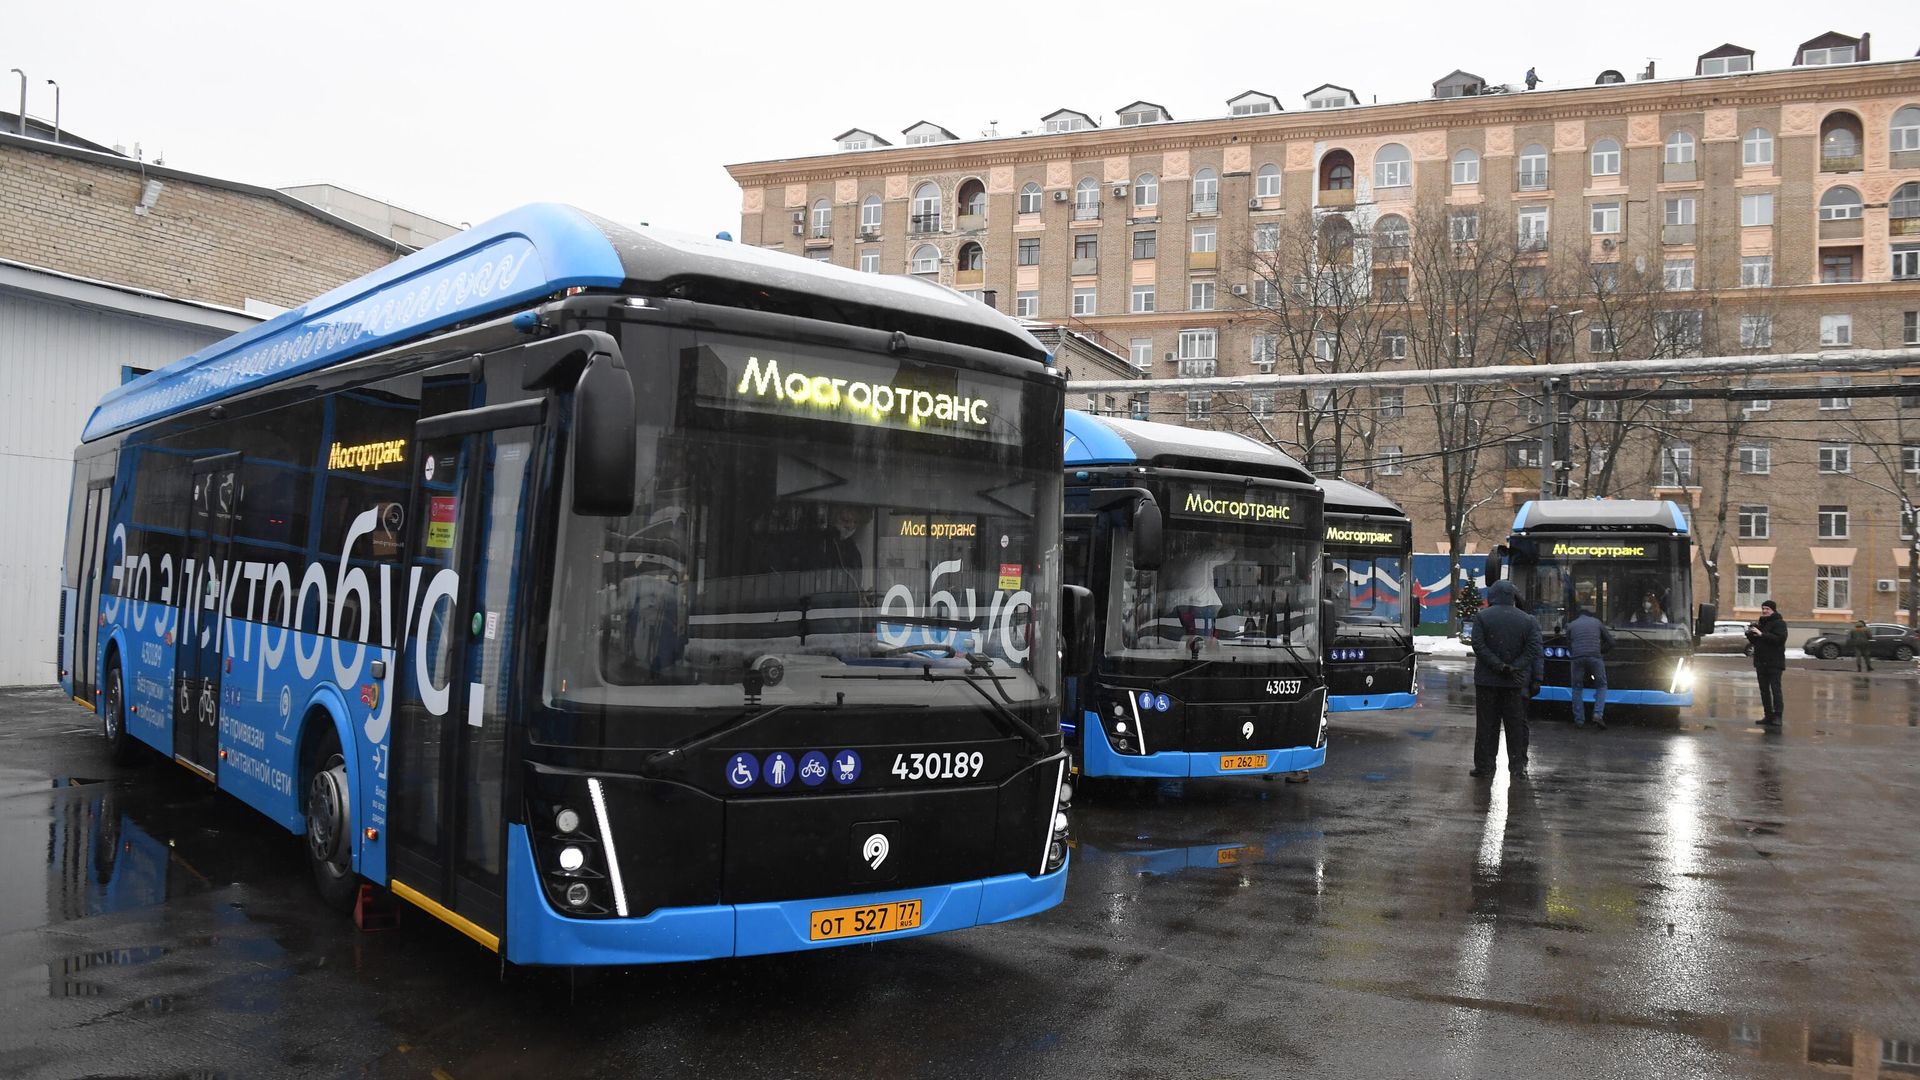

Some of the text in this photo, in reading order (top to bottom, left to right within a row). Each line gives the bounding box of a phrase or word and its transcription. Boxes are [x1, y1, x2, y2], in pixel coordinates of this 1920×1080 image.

[738, 356, 989, 427] Мосгортранс
[328, 439, 405, 471] Мосгортранс
[1184, 493, 1290, 520] Мосгортранс
[900, 520, 977, 539] Мосортранс
[1326, 527, 1393, 544] Мосгортранс
[1552, 543, 1644, 558] Мосгортранс
[105, 523, 150, 633] Это
[1266, 680, 1301, 694] 430337
[230, 718, 264, 750] привязан
[891, 752, 984, 780] 430189
[1224, 755, 1264, 768] ОТ 262 77
[271, 768, 292, 796] сети
[820, 903, 916, 935] ОТ 527 77
[900, 919, 913, 927] RUS
